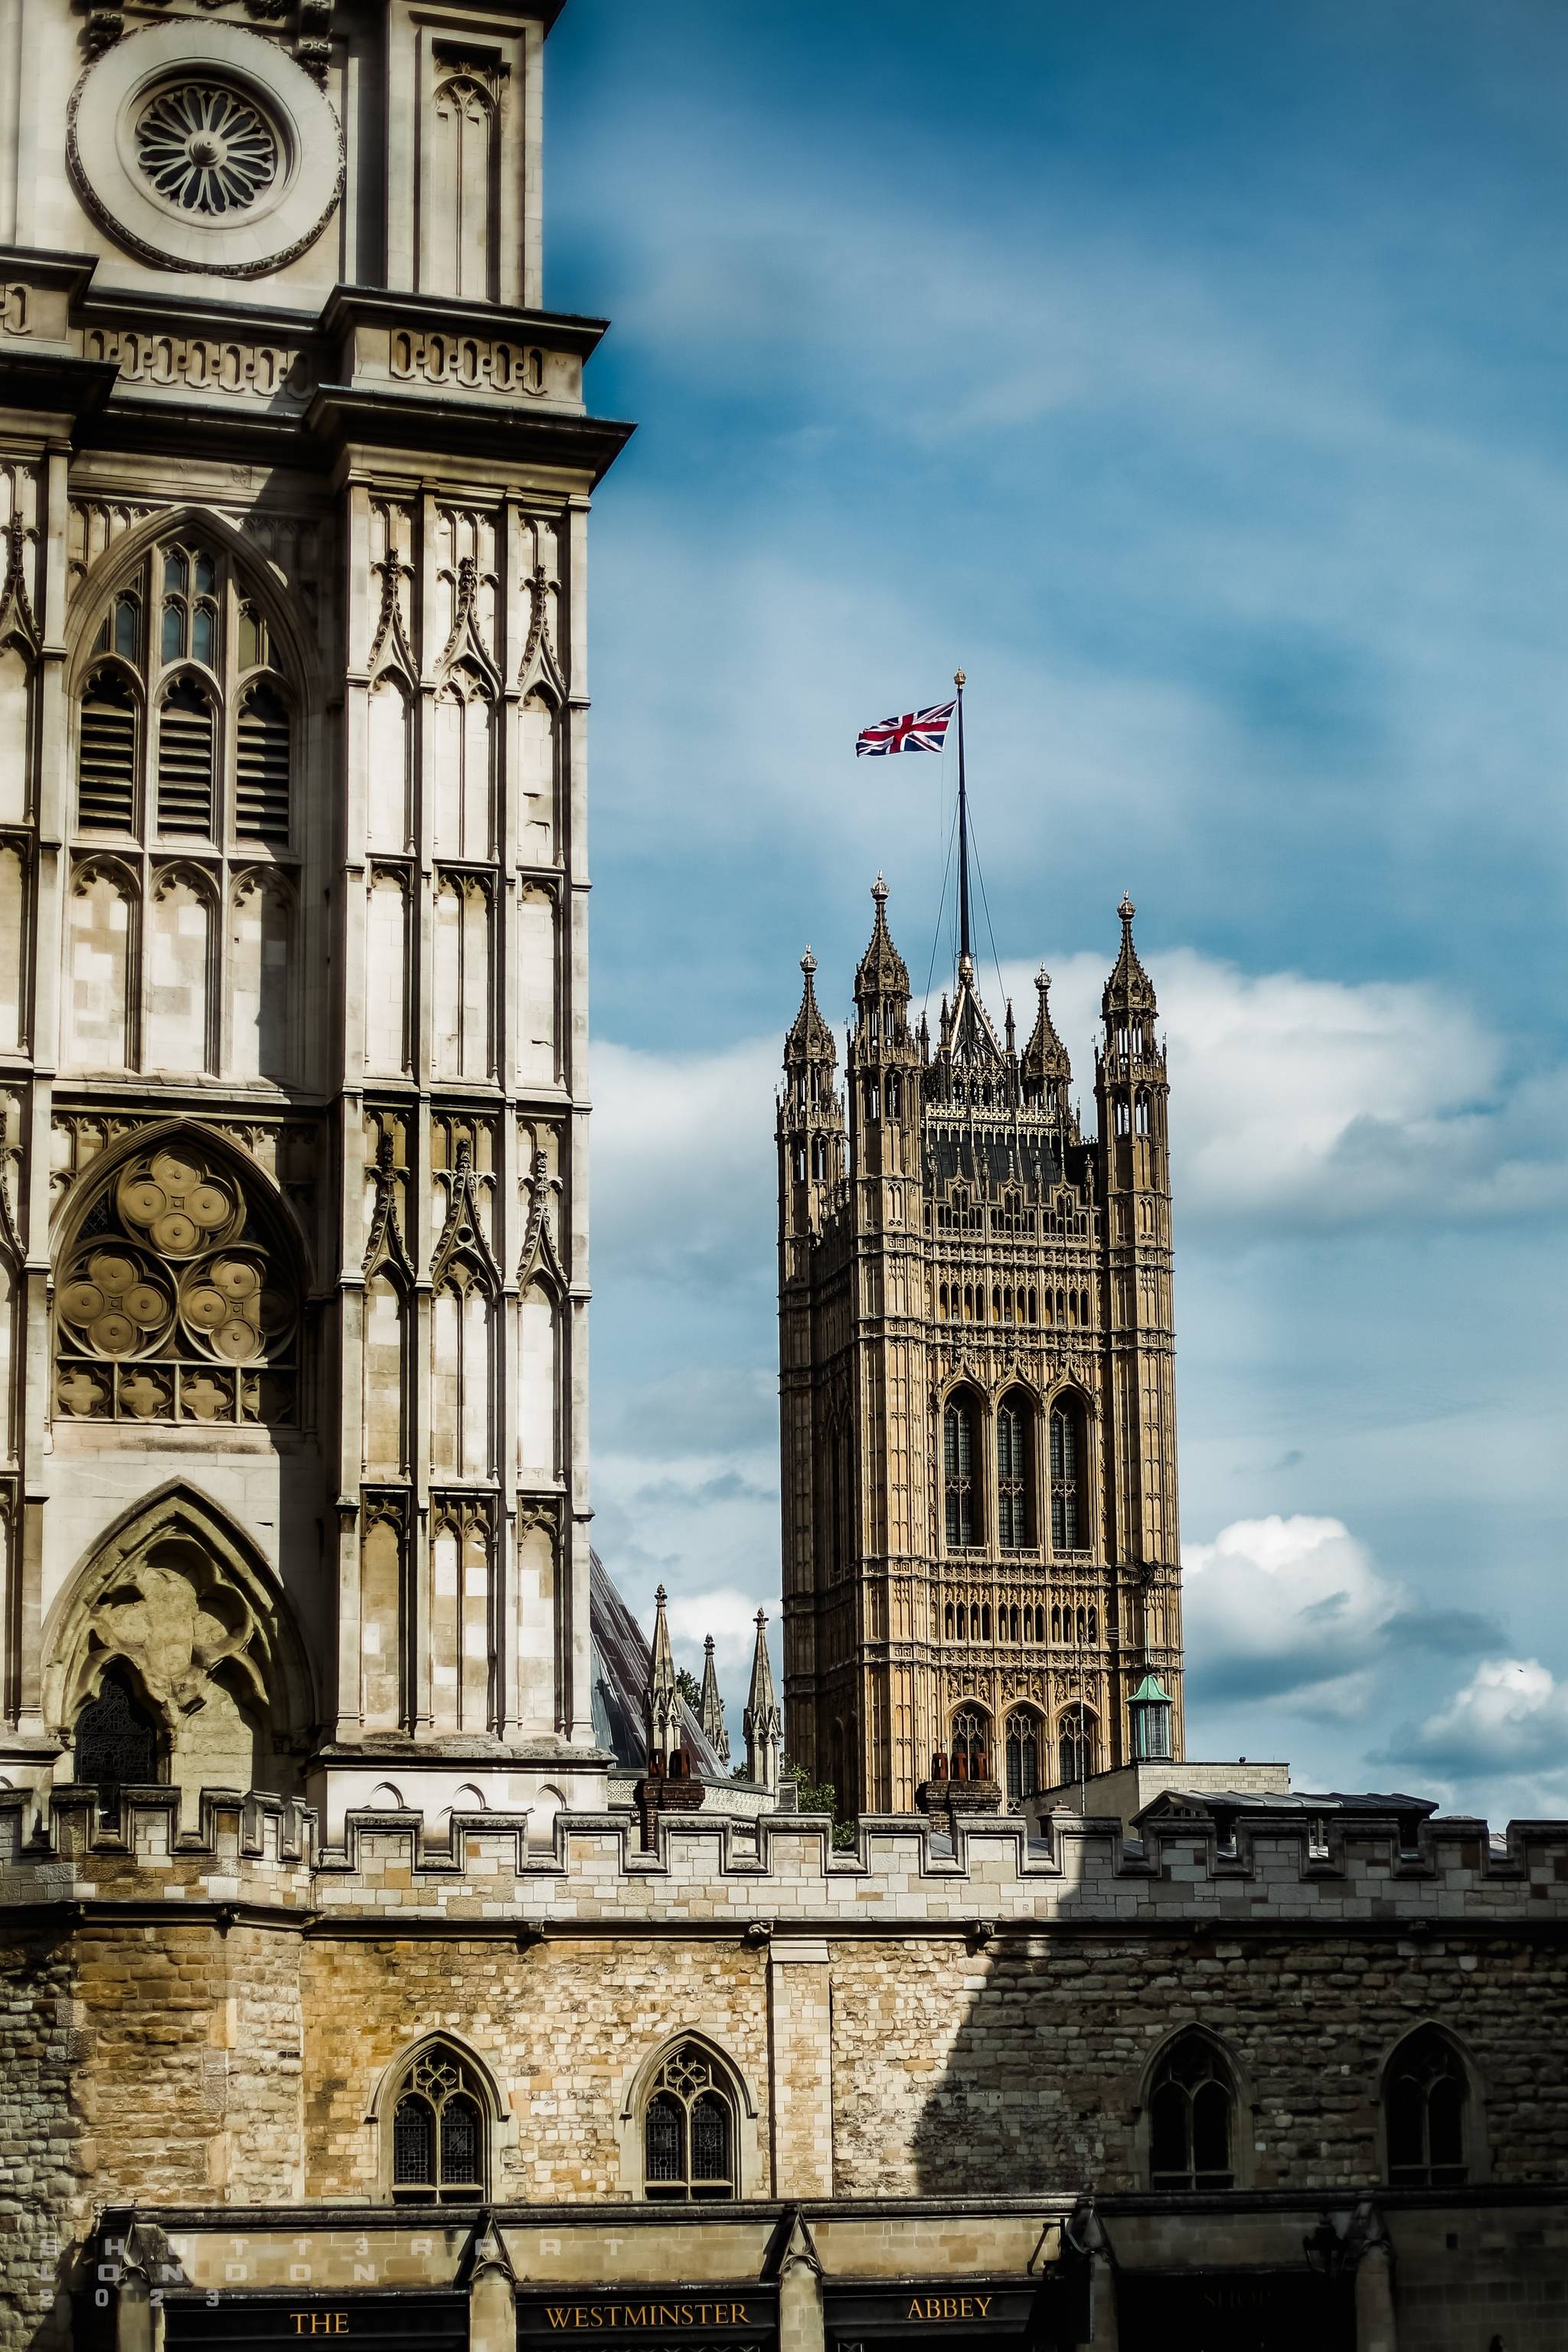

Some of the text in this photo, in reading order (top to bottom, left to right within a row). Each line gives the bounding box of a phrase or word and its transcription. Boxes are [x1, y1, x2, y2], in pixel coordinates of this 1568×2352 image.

[289, 2312, 350, 2334] THE
[544, 2302, 752, 2329] WESTMINSTER
[906, 2296, 993, 2320] ABBEY
